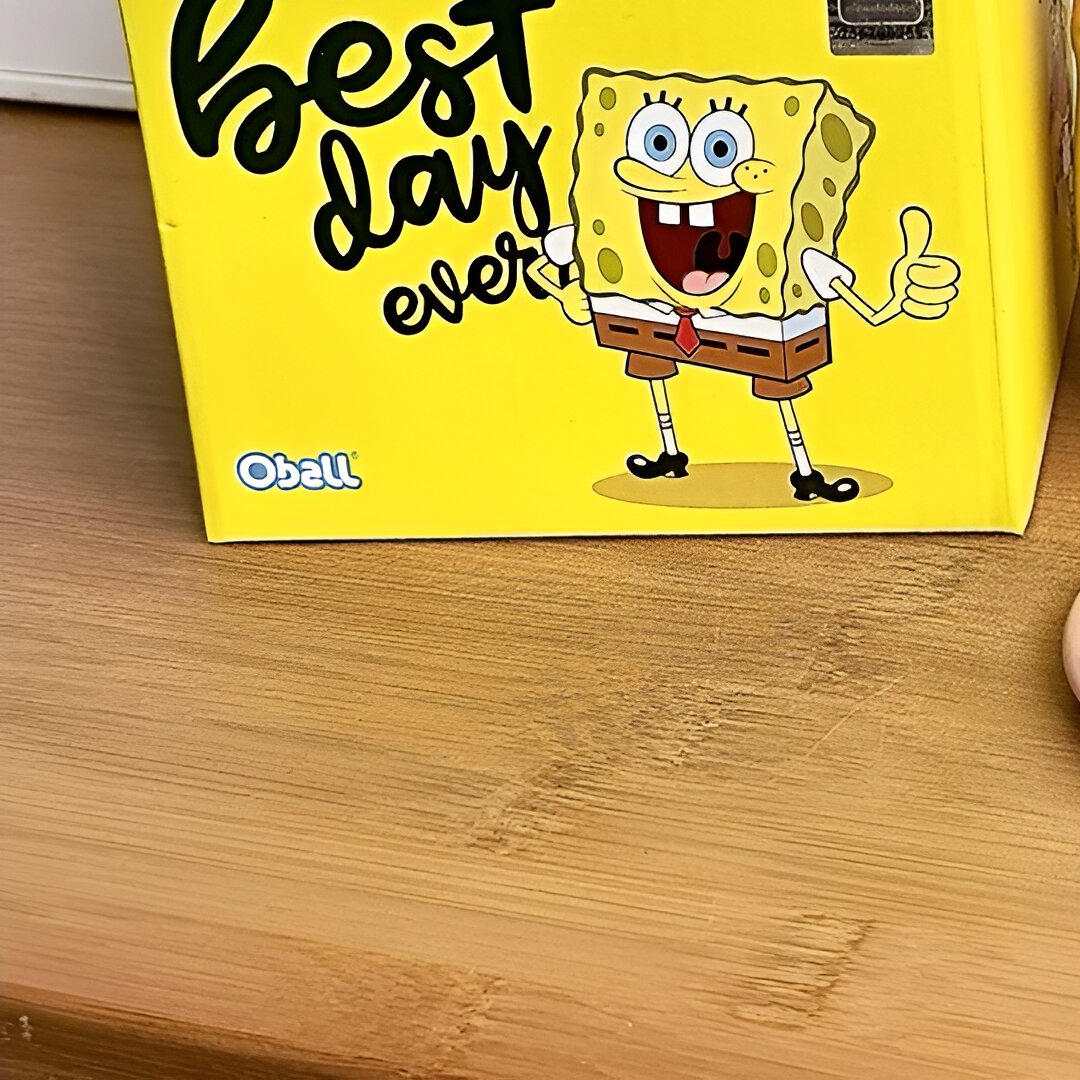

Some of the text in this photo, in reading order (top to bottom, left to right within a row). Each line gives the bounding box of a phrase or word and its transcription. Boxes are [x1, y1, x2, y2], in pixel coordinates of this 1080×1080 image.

[314, 120, 552, 271] day
[383, 231, 553, 335] ever
[237, 452, 362, 491] Oball
